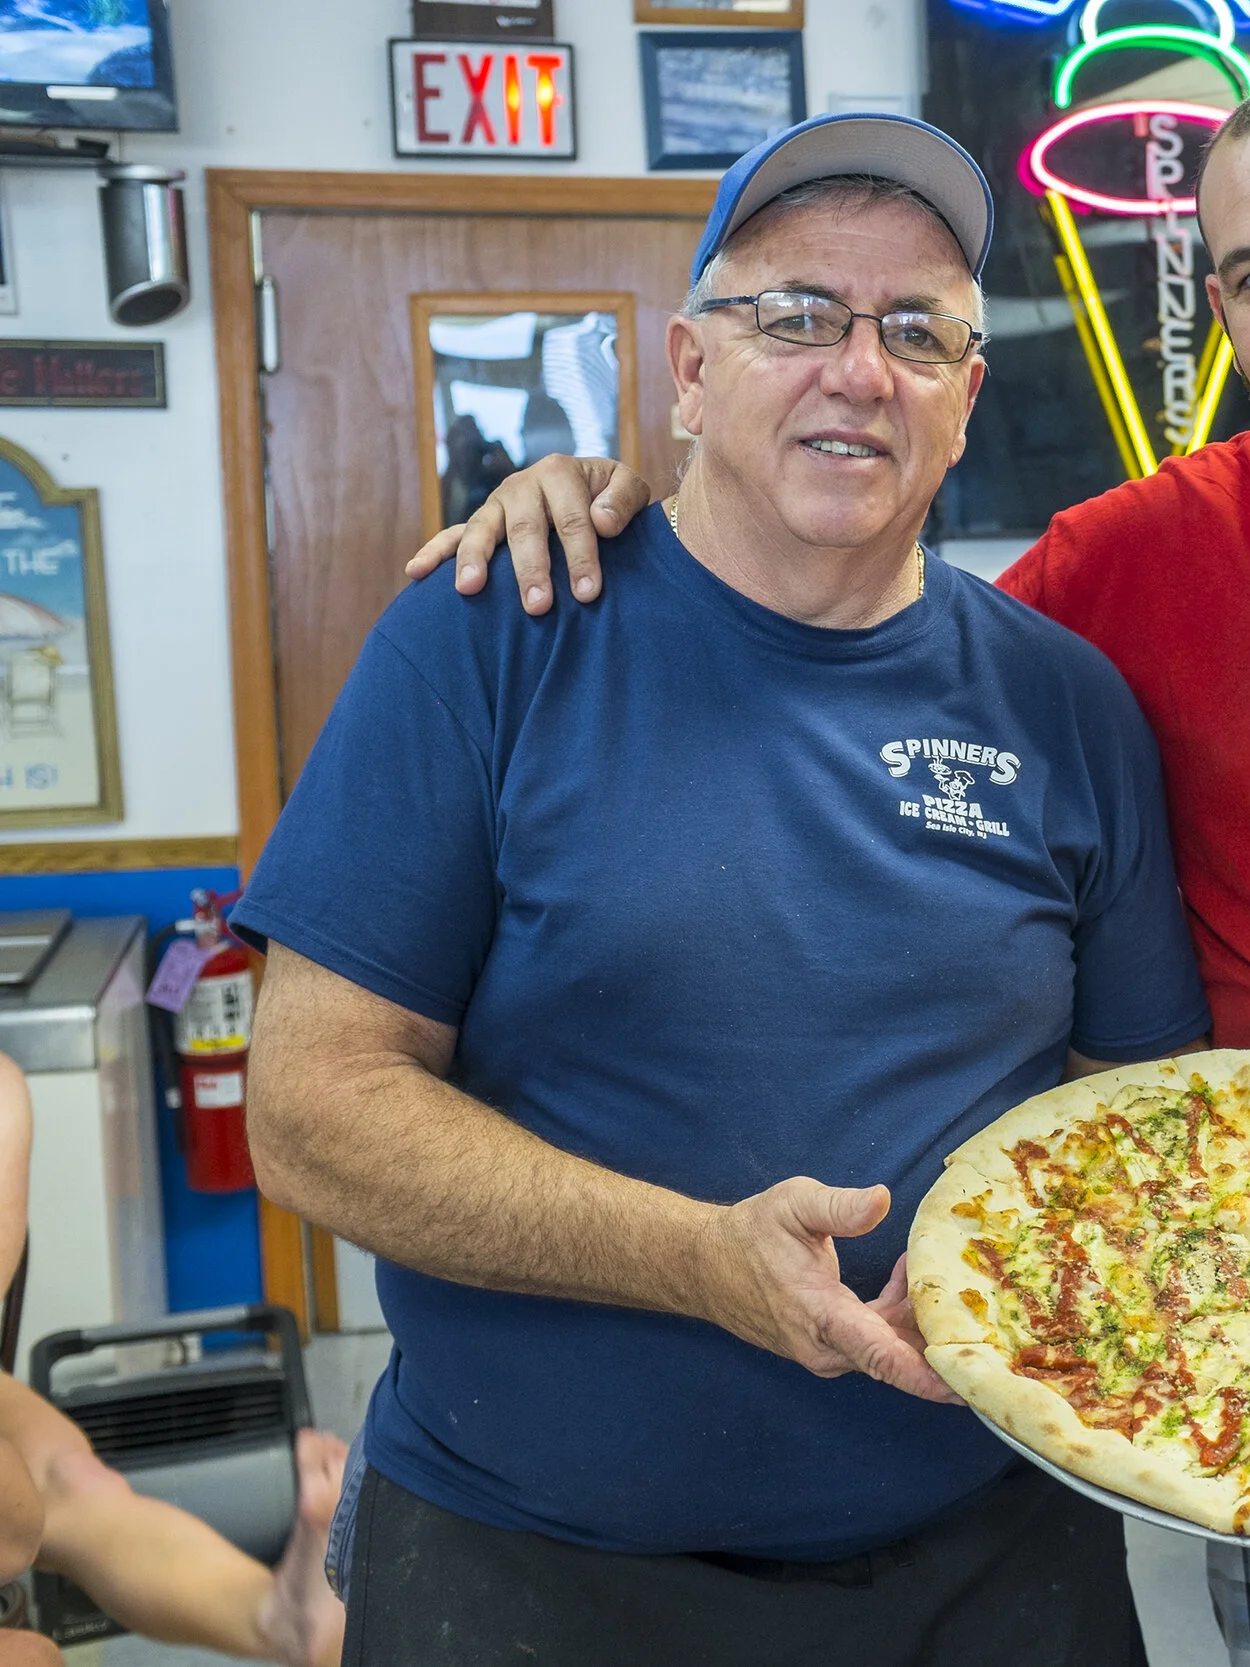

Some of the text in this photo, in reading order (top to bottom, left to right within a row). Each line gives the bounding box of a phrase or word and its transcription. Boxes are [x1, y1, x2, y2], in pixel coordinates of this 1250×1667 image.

[413, 53, 562, 145] EXIT
[3, 548, 58, 576] THE
[879, 738, 1021, 786] SPINNERS
[900, 800, 1010, 837] ICE CREAM GRILL
[921, 794, 984, 819] PIZZA
[925, 821, 987, 839] Sea Isle City, NJ
